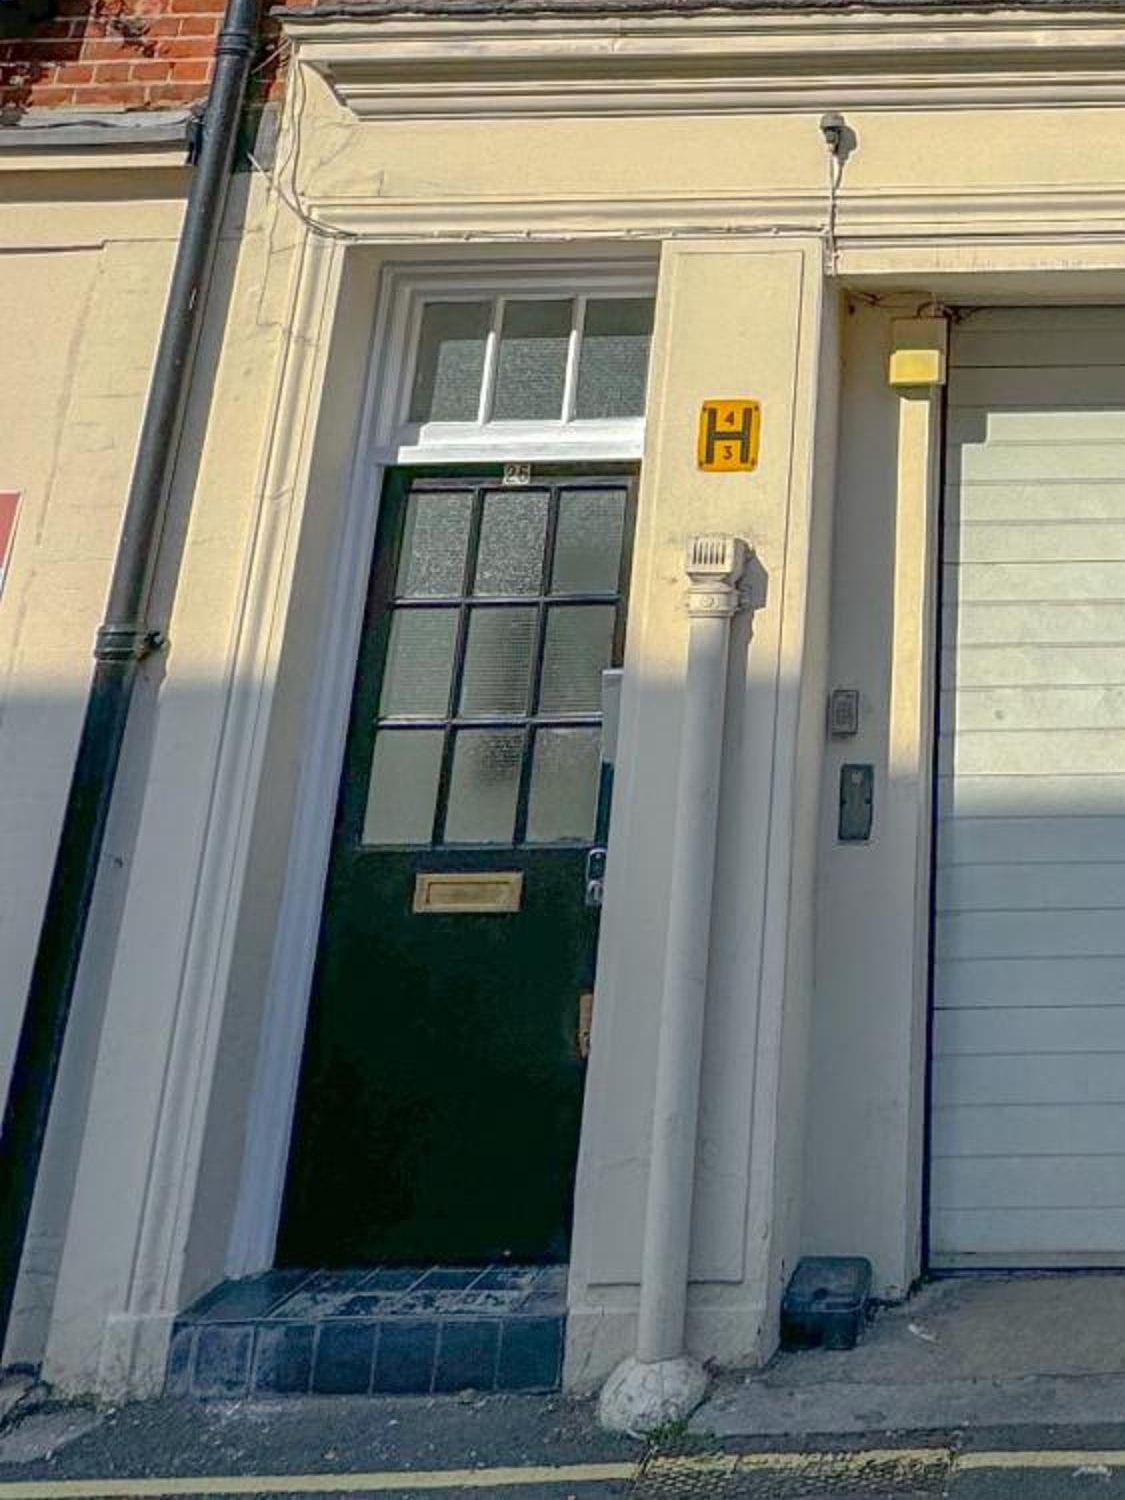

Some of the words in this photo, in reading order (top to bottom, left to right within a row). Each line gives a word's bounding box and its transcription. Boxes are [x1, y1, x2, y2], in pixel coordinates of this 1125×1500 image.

[724, 411, 735, 426] 4
[706, 408, 752, 464] H
[723, 445, 734, 460] 3
